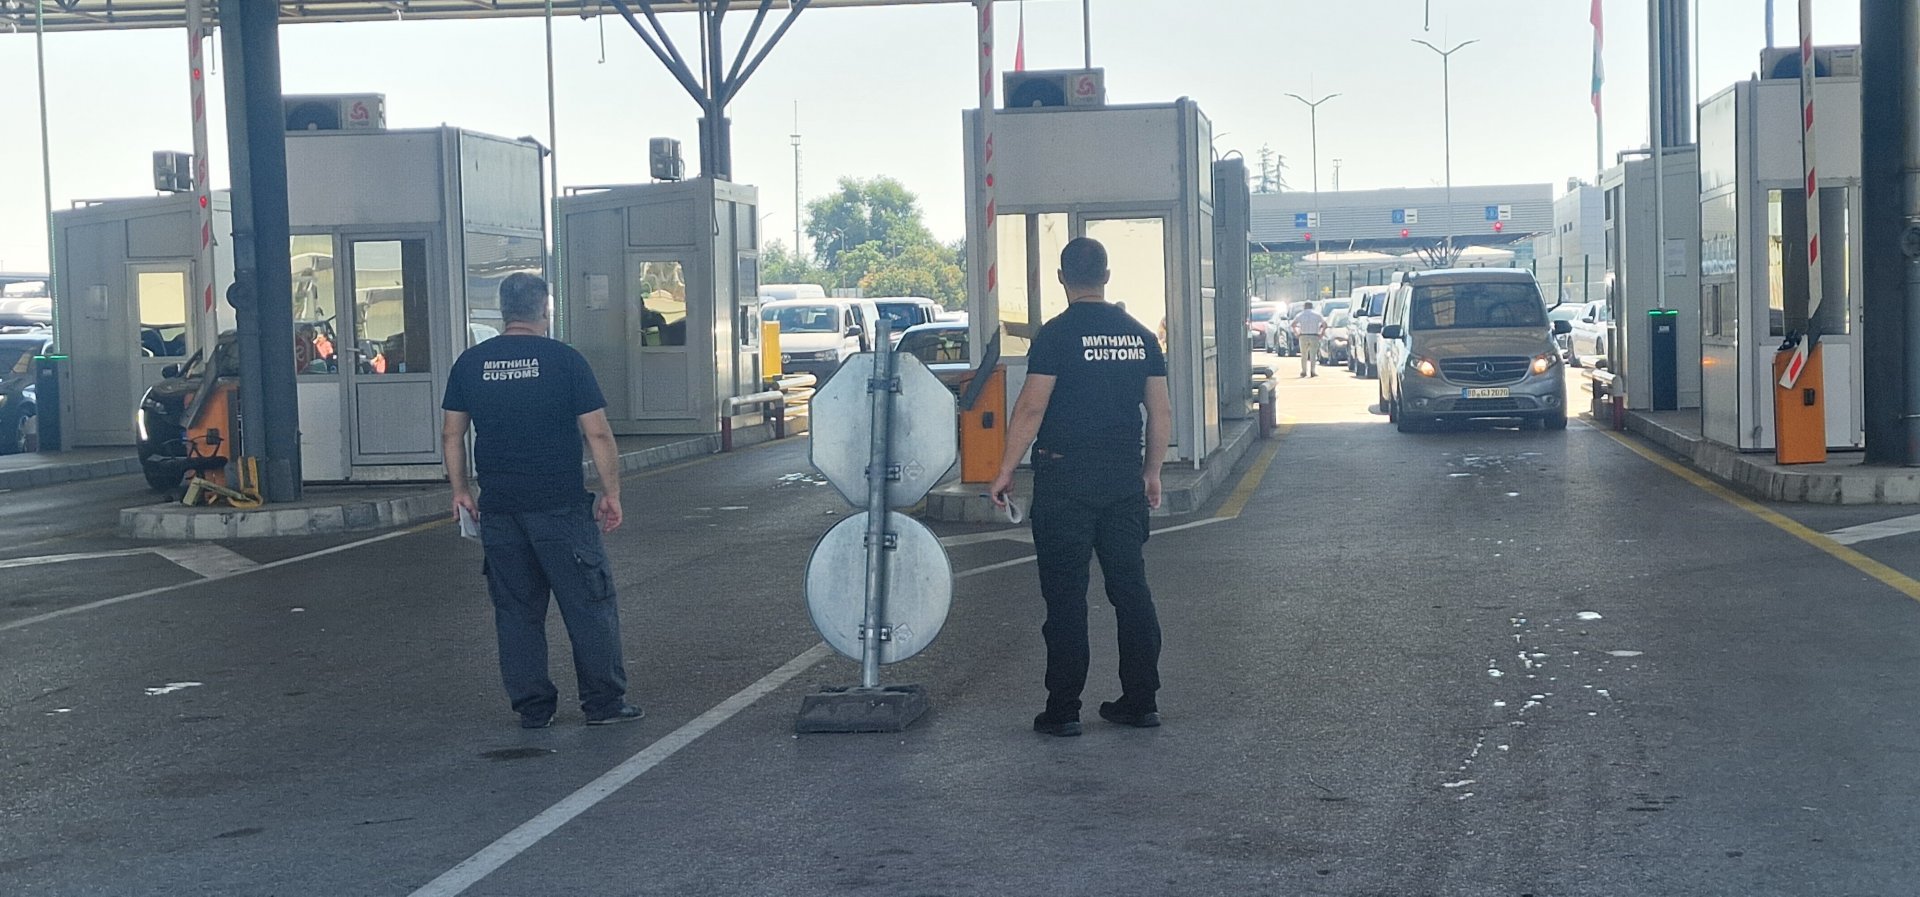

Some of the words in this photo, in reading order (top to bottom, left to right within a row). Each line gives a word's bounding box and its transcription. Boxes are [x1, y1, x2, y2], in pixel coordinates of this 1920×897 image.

[1082, 335, 1144, 347] МИТНИЦА
[1084, 348, 1146, 360] CUSTOMS
[484, 358, 539, 369] МИТНИЦА
[483, 369, 540, 380] CUSTOMS
